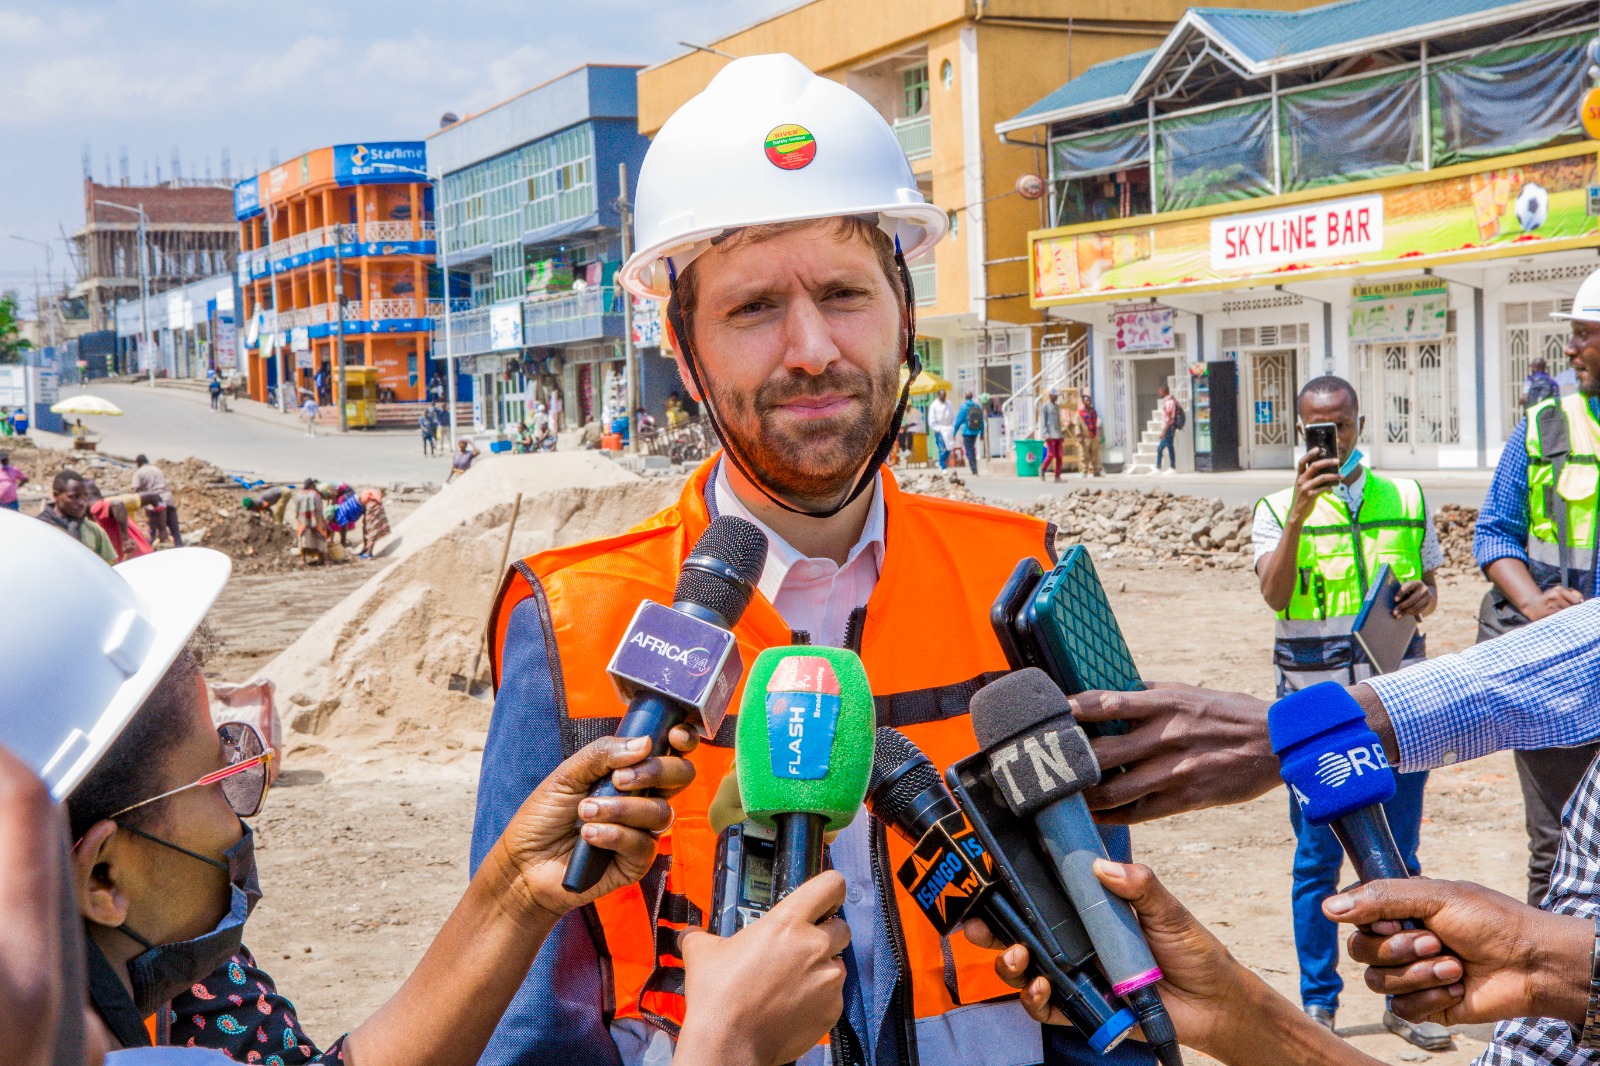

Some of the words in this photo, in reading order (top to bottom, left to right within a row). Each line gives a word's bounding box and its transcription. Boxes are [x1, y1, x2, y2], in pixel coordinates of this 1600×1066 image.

[775, 130, 798, 138] RIVER
[1327, 207, 1371, 247] BAR
[1415, 279, 1447, 290] SHOP
[802, 673, 812, 690] TV
[788, 706, 806, 775] FLASH
[989, 731, 1078, 806] TN
[915, 851, 963, 910] ISANGO
[960, 871, 979, 895] TV
